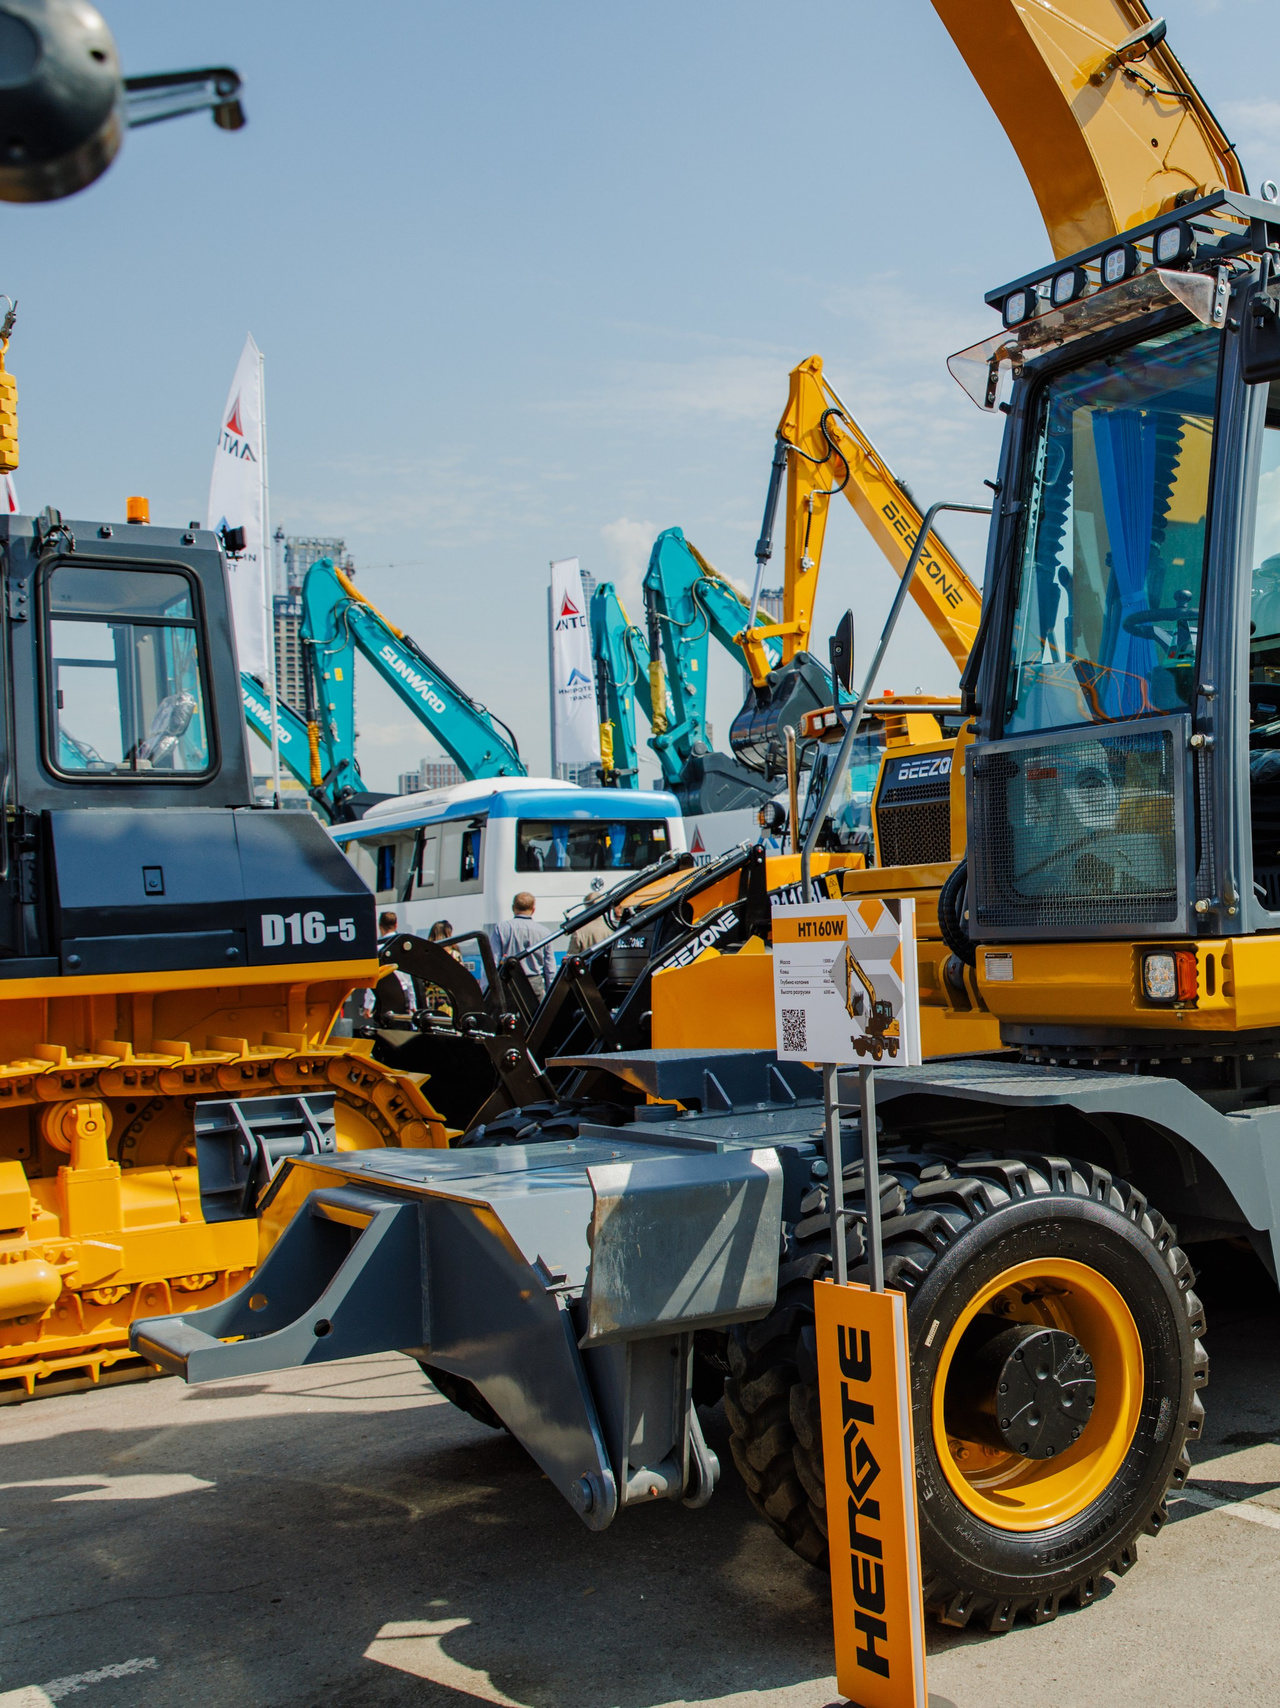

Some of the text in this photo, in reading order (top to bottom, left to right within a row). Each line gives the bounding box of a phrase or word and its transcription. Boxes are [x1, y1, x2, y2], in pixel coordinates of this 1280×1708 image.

[379, 645, 446, 714] SUNWARD
[898, 756, 952, 780] BEEZO
[261, 911, 356, 947] D16-5
[798, 921, 844, 937] HT160W
[837, 1324, 890, 1679] HENGTE
